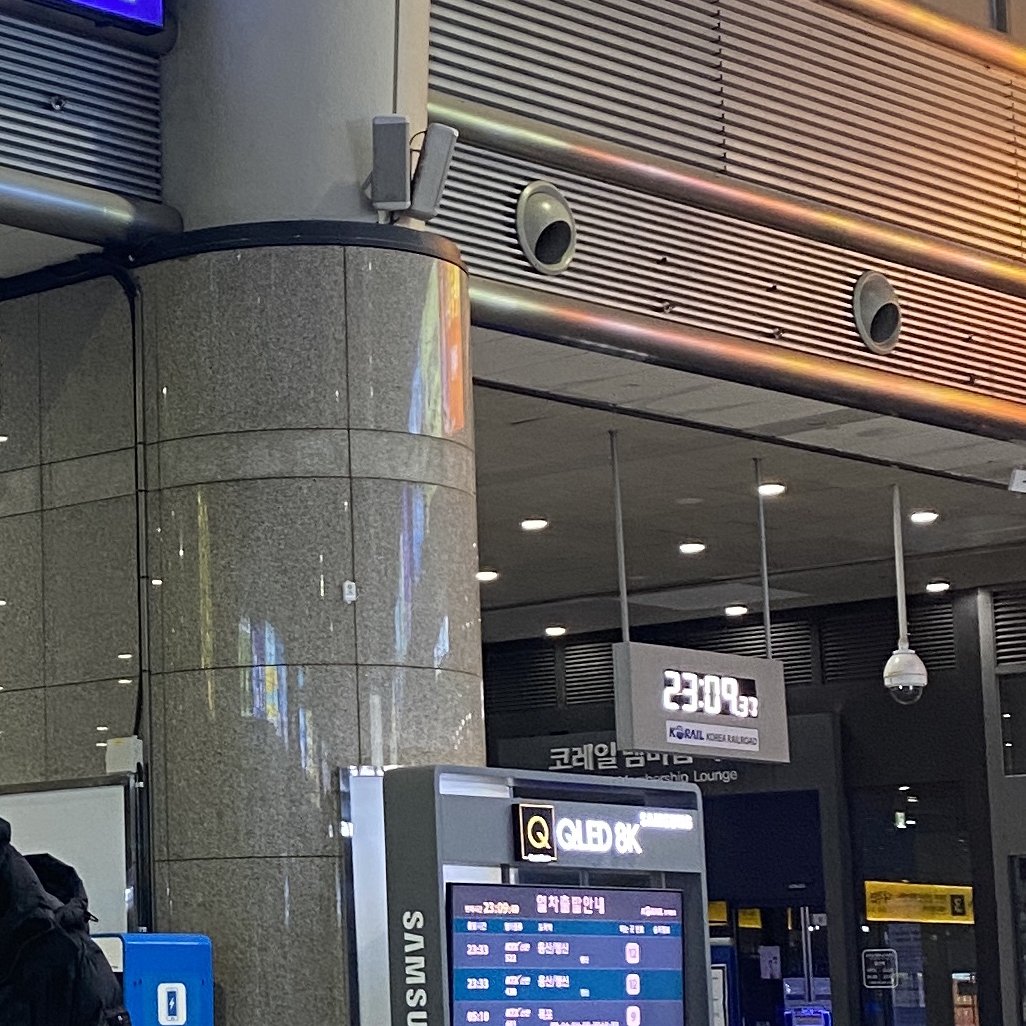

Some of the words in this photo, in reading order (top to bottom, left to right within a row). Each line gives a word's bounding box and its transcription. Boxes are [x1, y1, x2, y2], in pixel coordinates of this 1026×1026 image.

[663, 670, 739, 715] 23:09
[669, 725, 704, 741] KORAIL
[706, 733, 726, 742] KOREA
[727, 735, 758, 746] RAILROAD
[548, 741, 618, 770] 코레일
[694, 770, 738, 784] Lounge
[527, 815, 552, 849] Q
[556, 817, 613, 852] QLED
[614, 821, 643, 854] 8K
